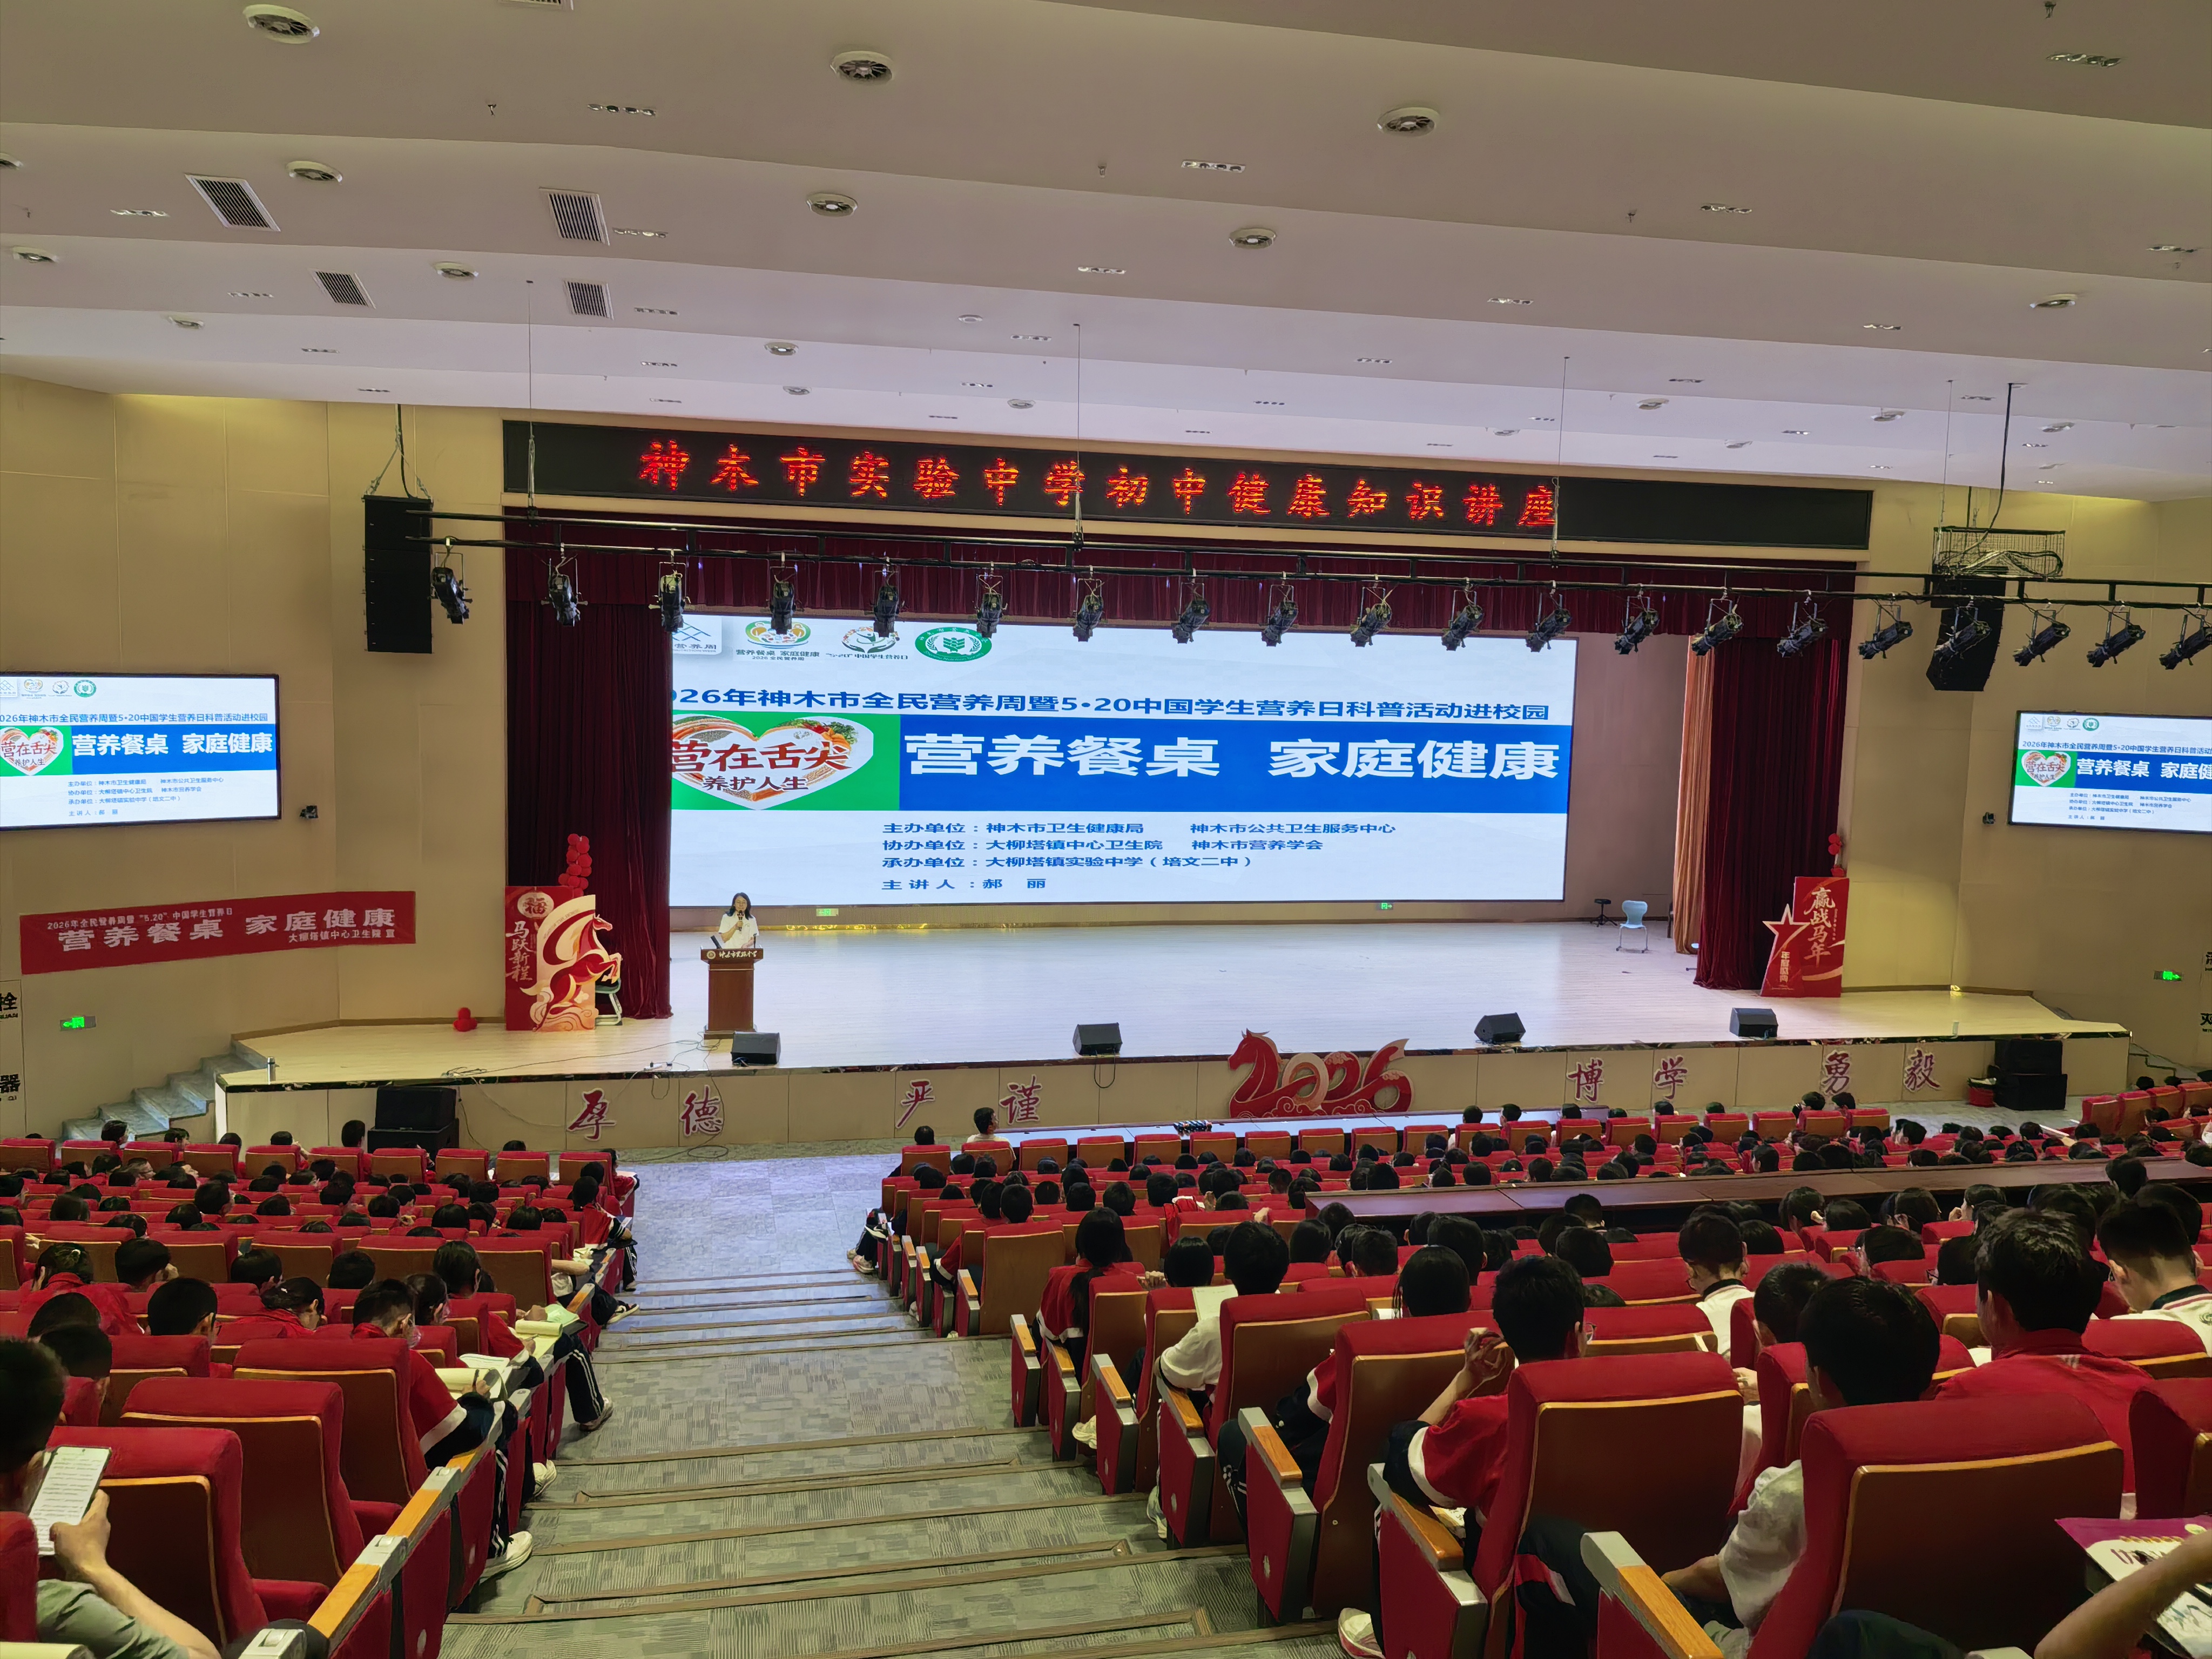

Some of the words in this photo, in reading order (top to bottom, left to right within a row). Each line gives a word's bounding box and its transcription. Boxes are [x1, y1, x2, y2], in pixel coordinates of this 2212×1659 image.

[639, 440, 1556, 528] 神木市实验中学初中健康知识讲座
[1, 740, 57, 758] 营在舌尖
[72, 733, 169, 757] 营养餐桌
[182, 732, 273, 754] 家庭健康
[905, 732, 1220, 777] 营养餐桌
[1269, 738, 1560, 780] 家庭健康
[2022, 740, 2212, 754] 2026年神木市全民营养周暨5·20中国学生营养日科普活动
[671, 740, 851, 773] 营在舌尖
[2076, 758, 2150, 778] 营养餐桌
[703, 775, 808, 791] 养护人生
[1190, 823, 1397, 834] 神木市公共卫生服务中心
[1191, 840, 1323, 851] 神木市营养学会
[58, 919, 224, 952] 营养餐桌
[245, 908, 395, 935] 家庭健康
[1804, 887, 1836, 968] 赢战马年
[505, 920, 536, 982] 马跃新程
[0, 1073, 21, 1094] 器
